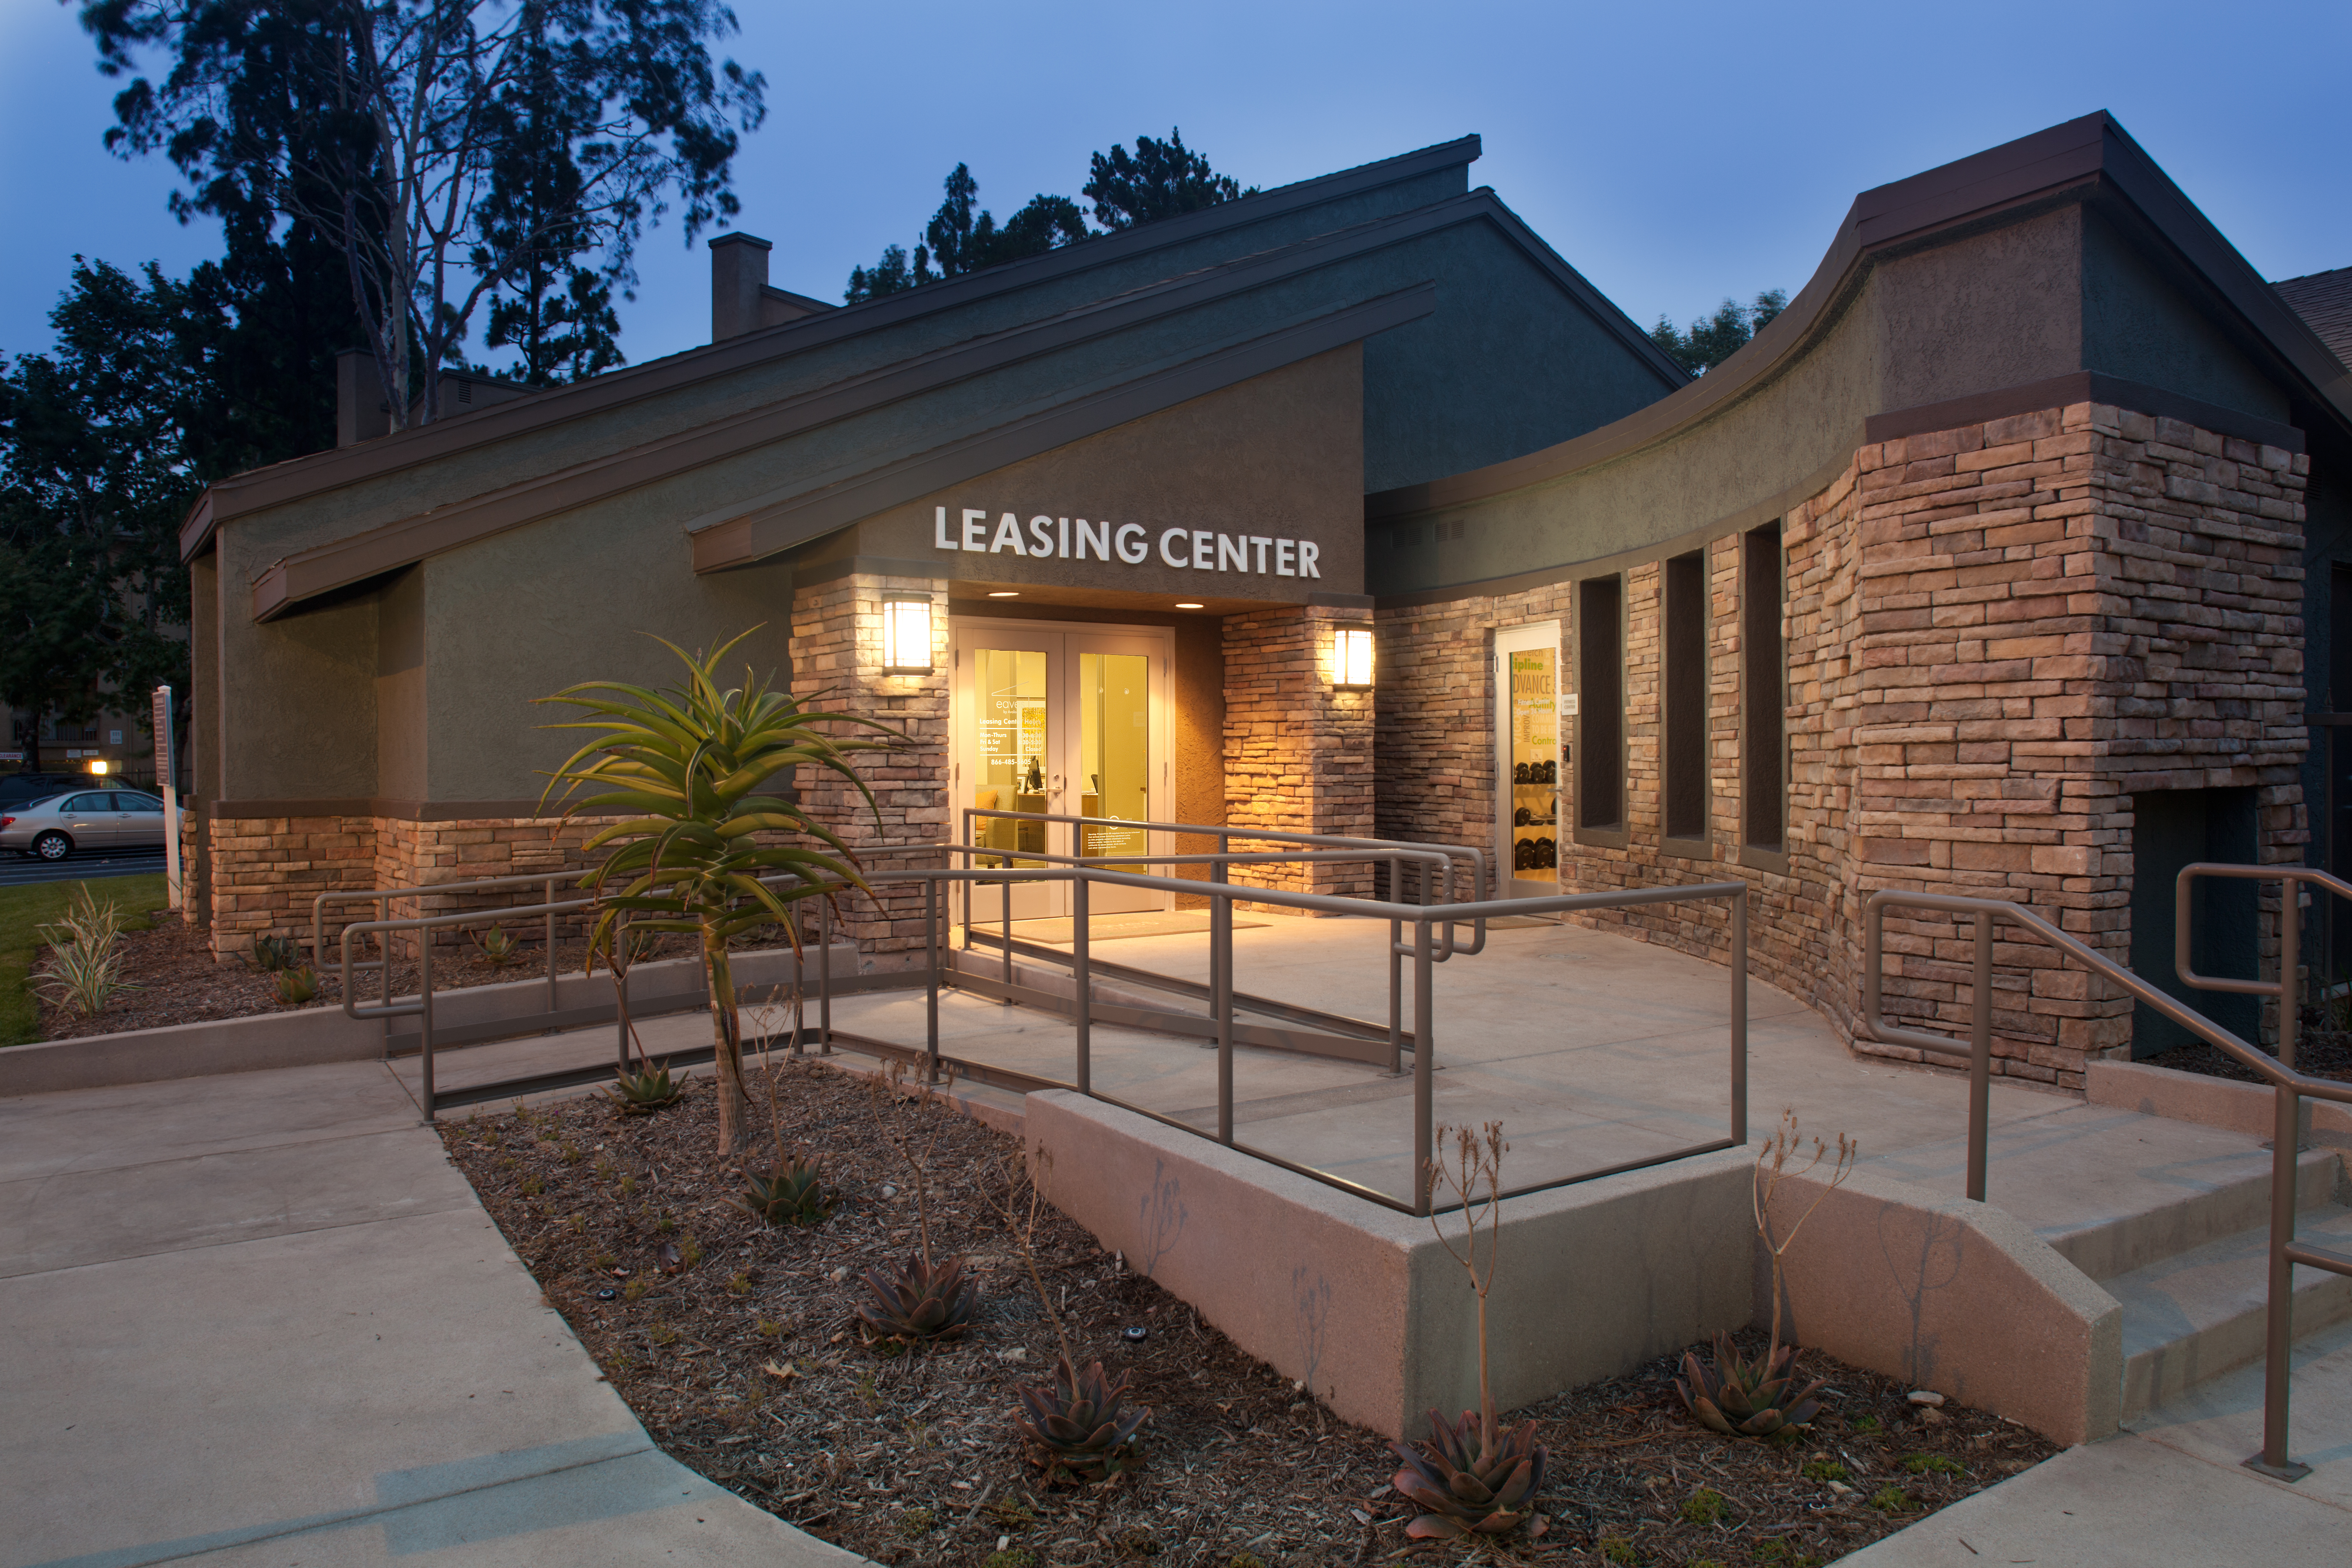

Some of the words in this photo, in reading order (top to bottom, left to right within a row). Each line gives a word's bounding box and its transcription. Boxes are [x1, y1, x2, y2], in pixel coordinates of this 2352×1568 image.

[935, 505, 1148, 564] LEASING
[1159, 527, 1321, 578] CENTER
[1532, 725, 1539, 734] TO
[1541, 725, 1547, 734] BE
